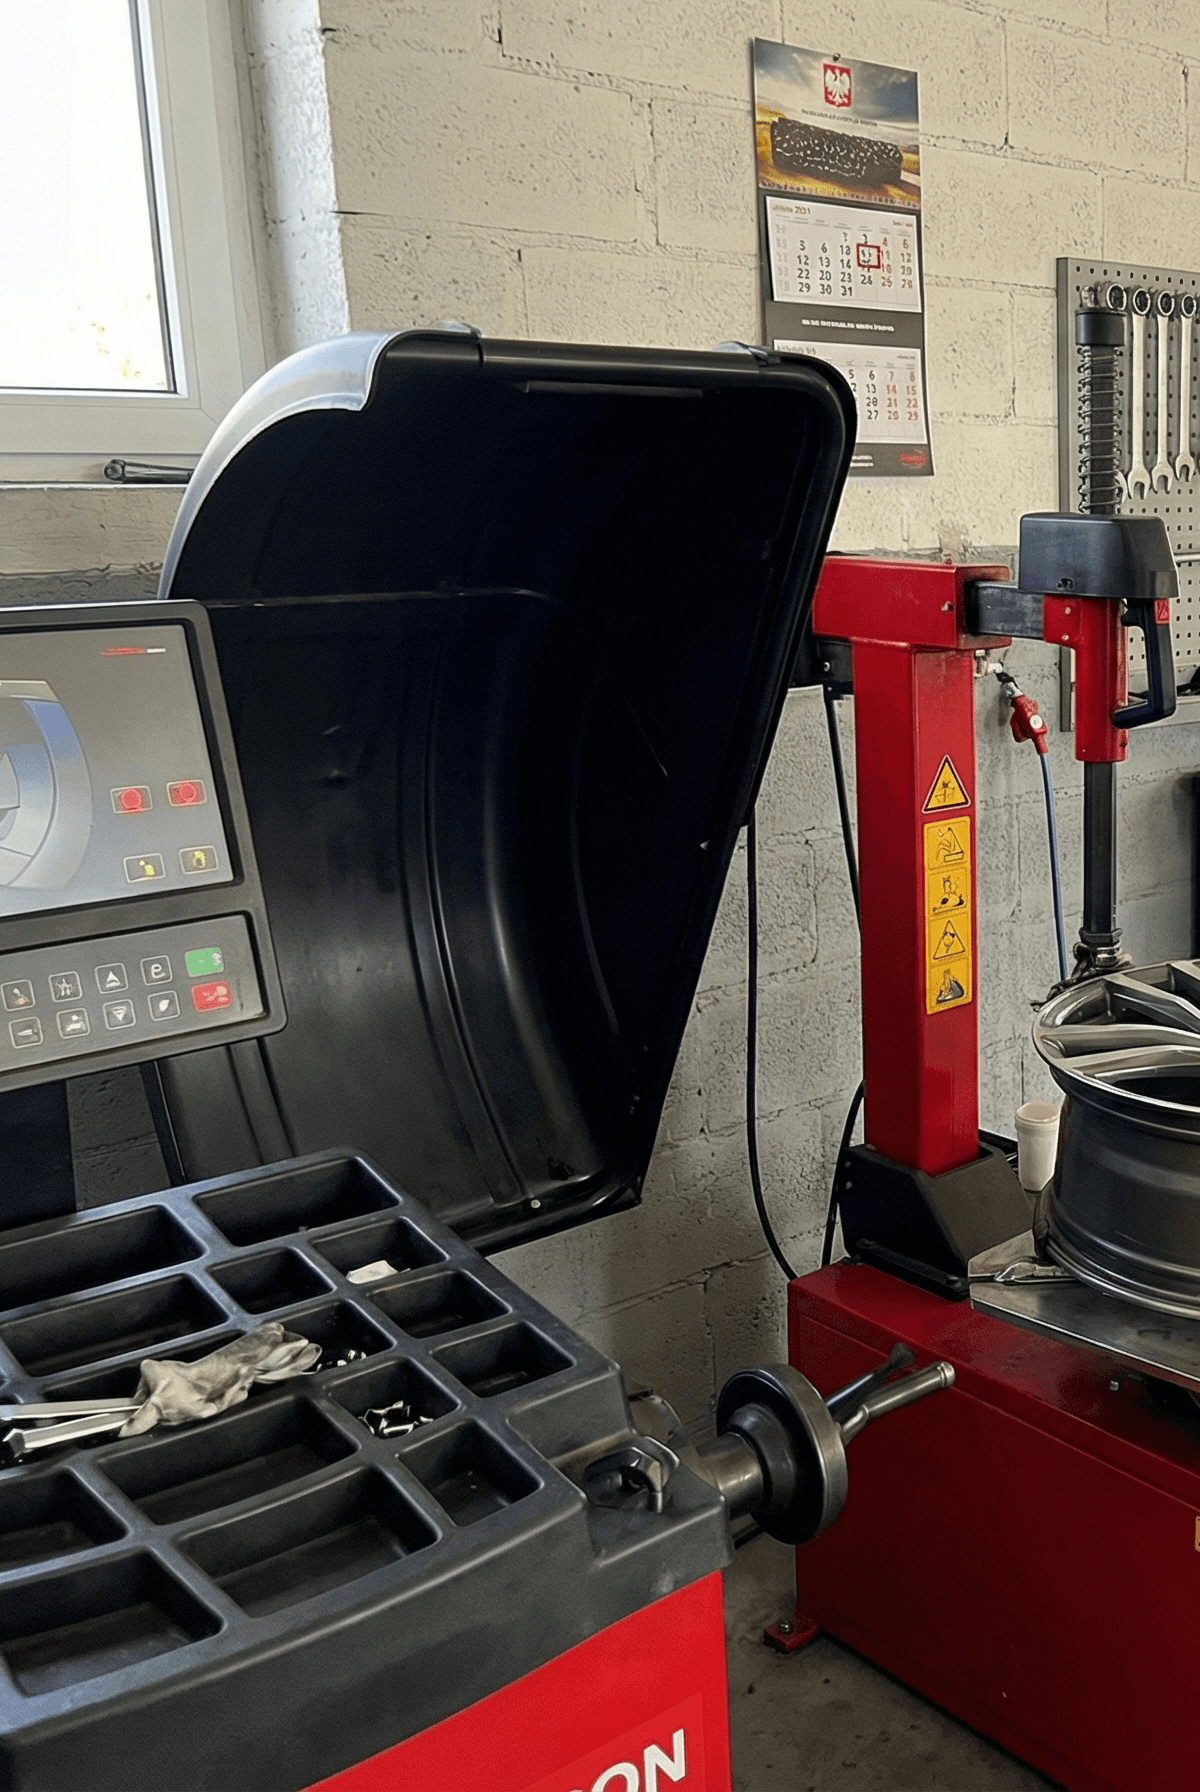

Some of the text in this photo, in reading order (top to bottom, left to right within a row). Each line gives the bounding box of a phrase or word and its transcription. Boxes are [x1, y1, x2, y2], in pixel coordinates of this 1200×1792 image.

[797, 254, 810, 266] 12
[797, 268, 810, 280] 22
[819, 270, 832, 281] 20
[840, 272, 852, 283] 23
[798, 282, 811, 293] 29
[819, 284, 832, 295] 30
[869, 369, 876, 381] 6
[906, 398, 918, 408] 22
[867, 410, 879, 420] 27
[569, 1728, 686, 1792] ON
